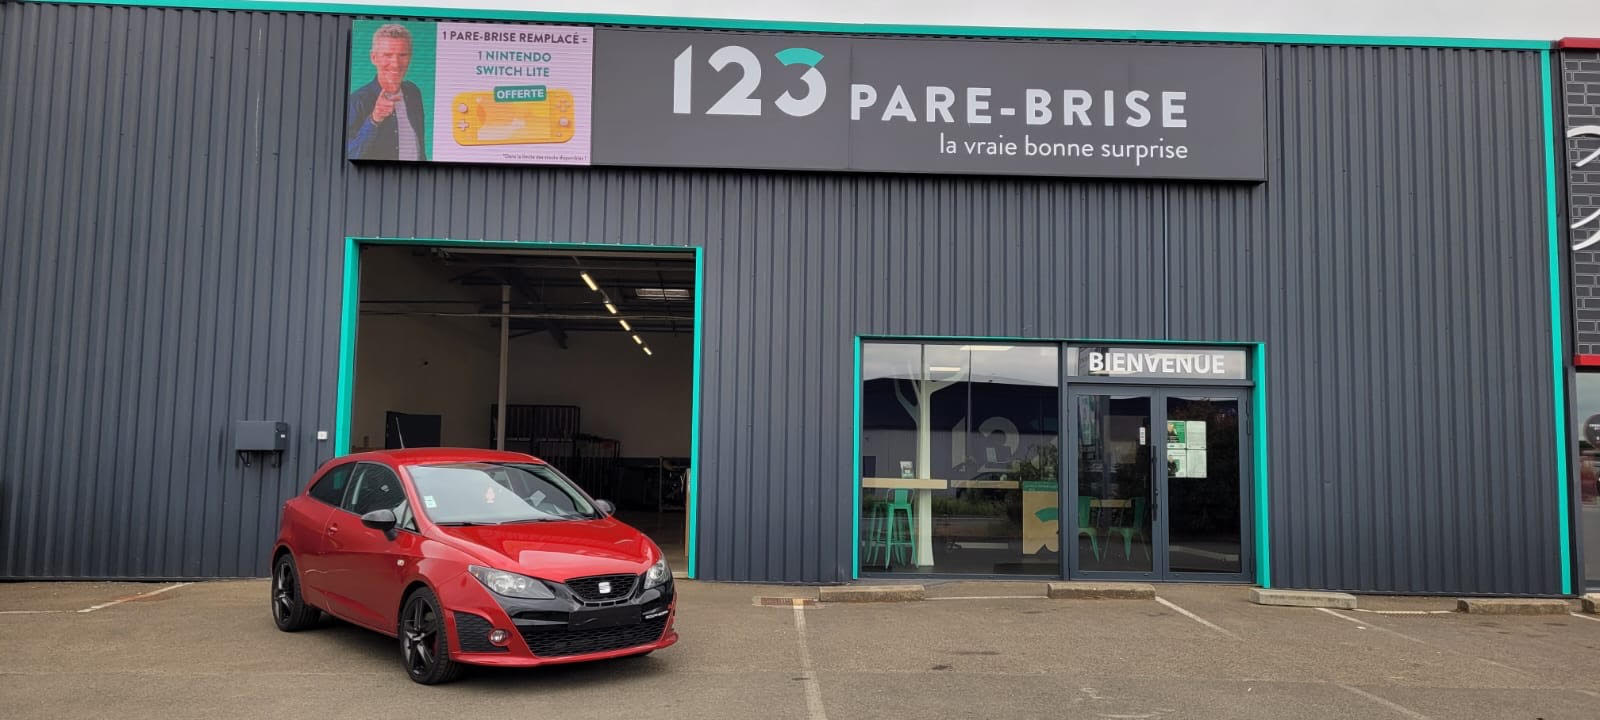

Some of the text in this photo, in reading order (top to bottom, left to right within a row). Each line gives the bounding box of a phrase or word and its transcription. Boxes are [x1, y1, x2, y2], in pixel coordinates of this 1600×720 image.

[442, 31, 447, 41] 1
[450, 31, 516, 42] PARE-BRISE
[519, 32, 580, 45] REMPLACÉ
[478, 51, 552, 62] 1 NINTENDO
[476, 65, 550, 77] SWITCH LITE
[673, 44, 827, 117] 123
[496, 88, 545, 99] OFFERTE
[850, 83, 1188, 129] PARE-BRISE
[940, 132, 1188, 167] la vraie bonne surprise
[1088, 352, 1225, 375] BIENVENUE
